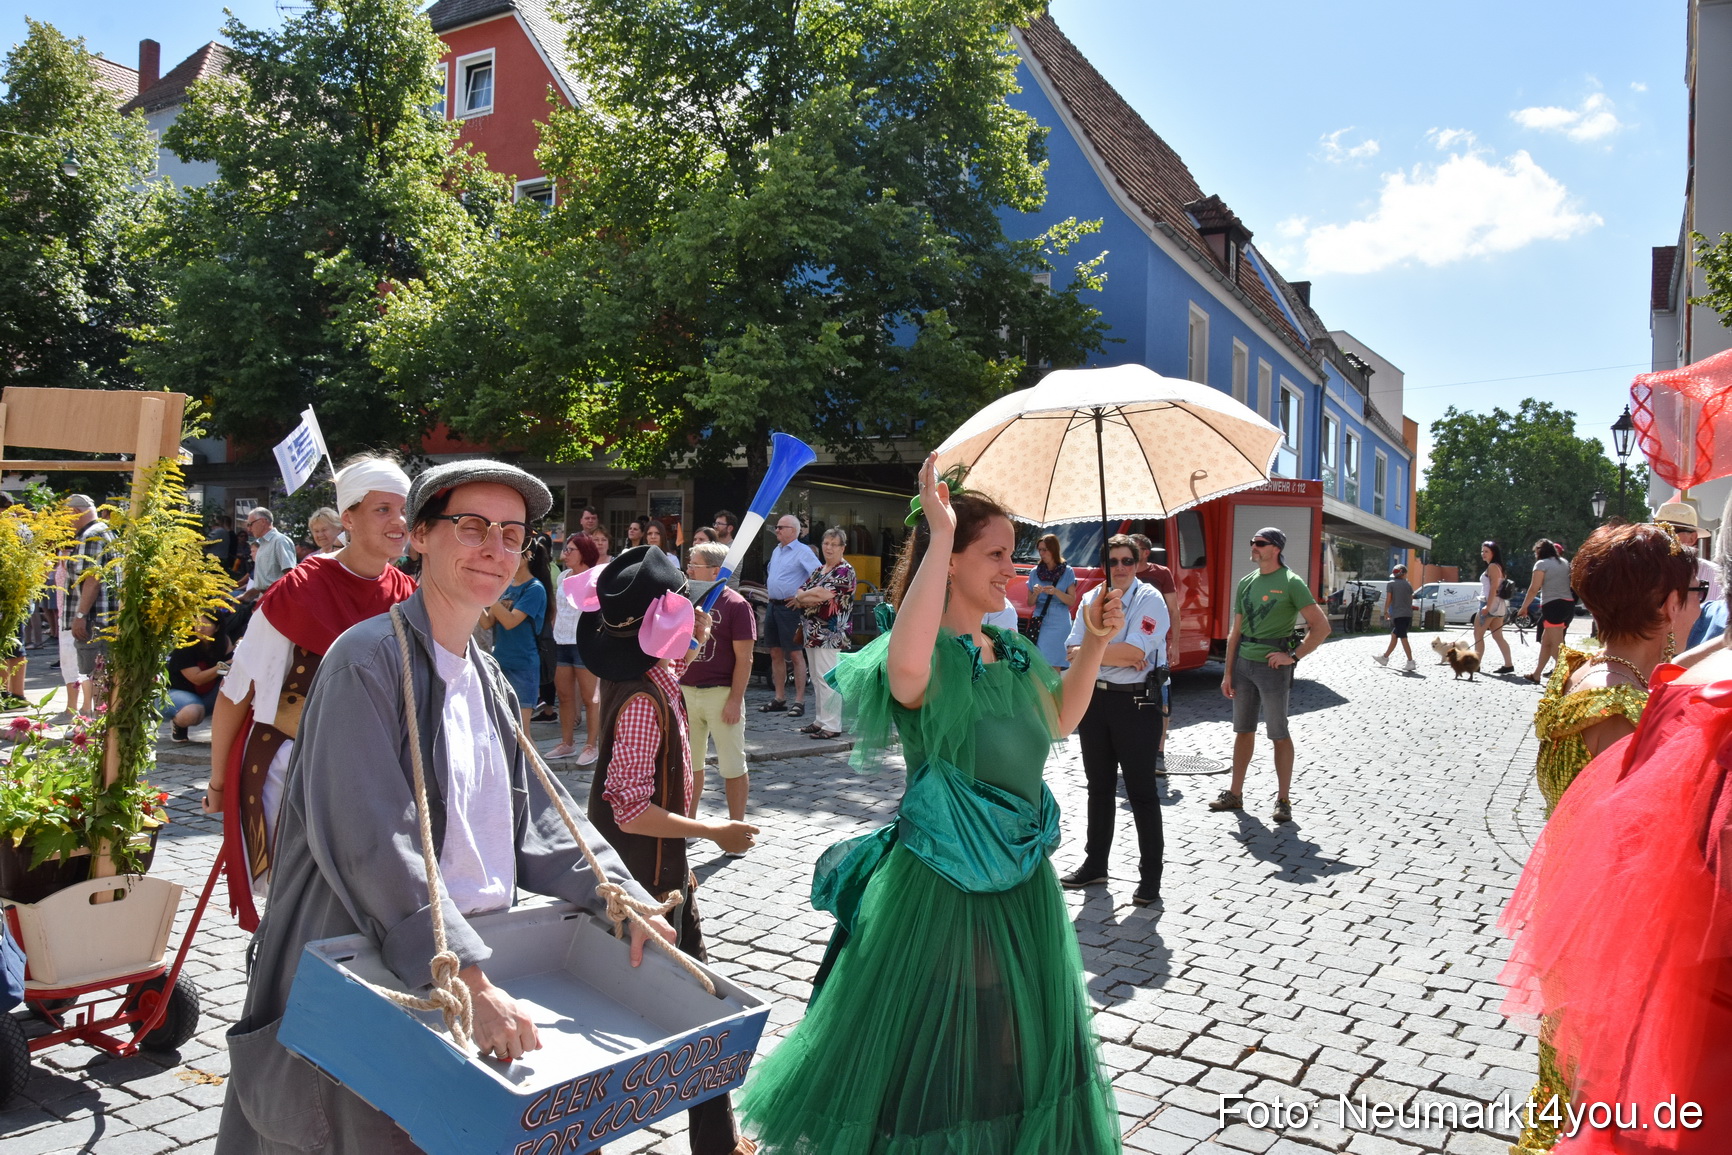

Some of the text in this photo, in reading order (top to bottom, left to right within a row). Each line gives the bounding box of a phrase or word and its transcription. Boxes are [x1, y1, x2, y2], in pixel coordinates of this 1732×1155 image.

[1297, 482, 1307, 494] 112
[520, 1030, 731, 1131] GEEK GOODS
[588, 1081, 677, 1142] GOOD
[679, 1051, 754, 1101] GREEK
